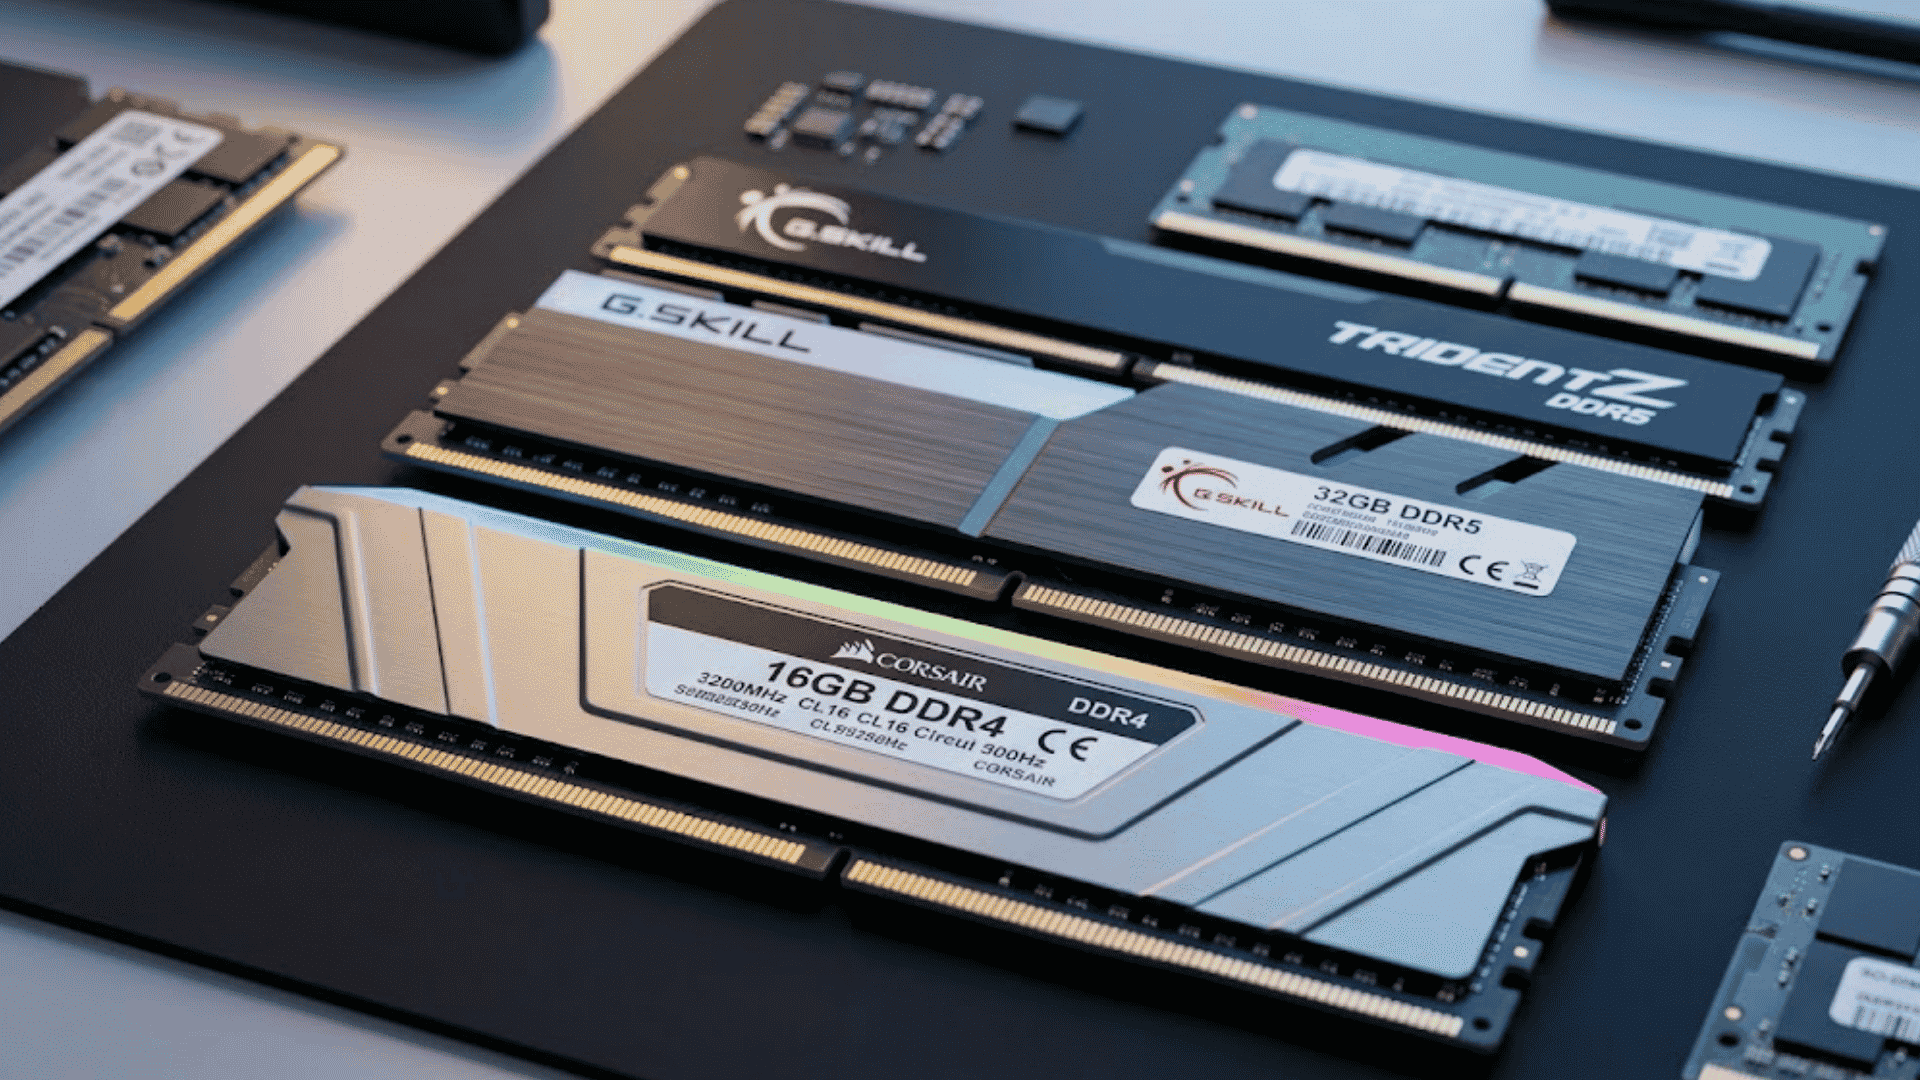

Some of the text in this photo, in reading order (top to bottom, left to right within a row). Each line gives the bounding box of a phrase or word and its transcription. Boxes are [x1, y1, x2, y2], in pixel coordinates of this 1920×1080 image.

[600, 292, 812, 354] G.SKILL
[1545, 391, 1657, 426] DDR5
[1313, 485, 1392, 514] 32GB
[1400, 503, 1484, 535] DDR5
[697, 671, 788, 704] 3200MHz
[767, 660, 1008, 738] 16GB DDR4
[876, 652, 1150, 729] CORSAIR DDR4
[973, 760, 1056, 787] CORSAIR
